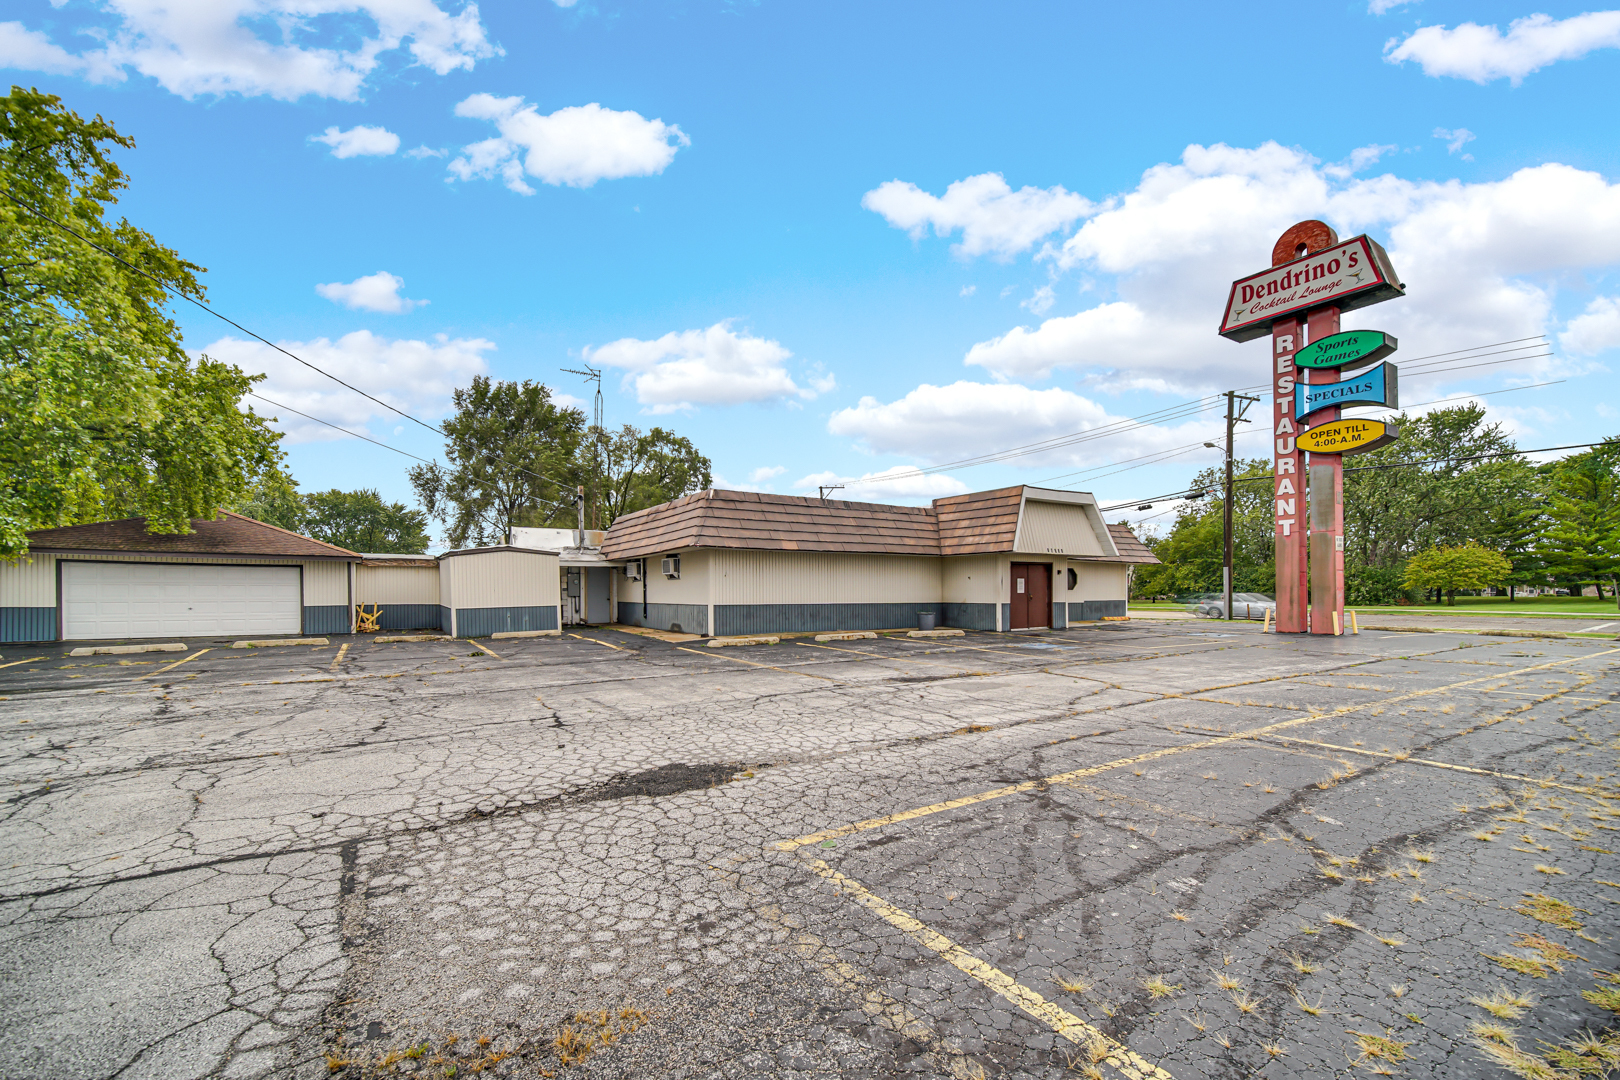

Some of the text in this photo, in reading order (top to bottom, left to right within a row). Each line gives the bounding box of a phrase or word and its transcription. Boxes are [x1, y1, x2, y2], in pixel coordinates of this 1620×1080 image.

[1241, 250, 1358, 304] Dendrino's
[1250, 279, 1342, 315] Cocktail Lounge
[1315, 336, 1359, 354] Sports
[1313, 348, 1361, 365] Games
[1305, 382, 1373, 404] SPECIALS
[1276, 334, 1296, 536] RESTAURANT
[1310, 423, 1370, 439] OPEN TILL
[1314, 433, 1365, 447] 4:00-A.M.
